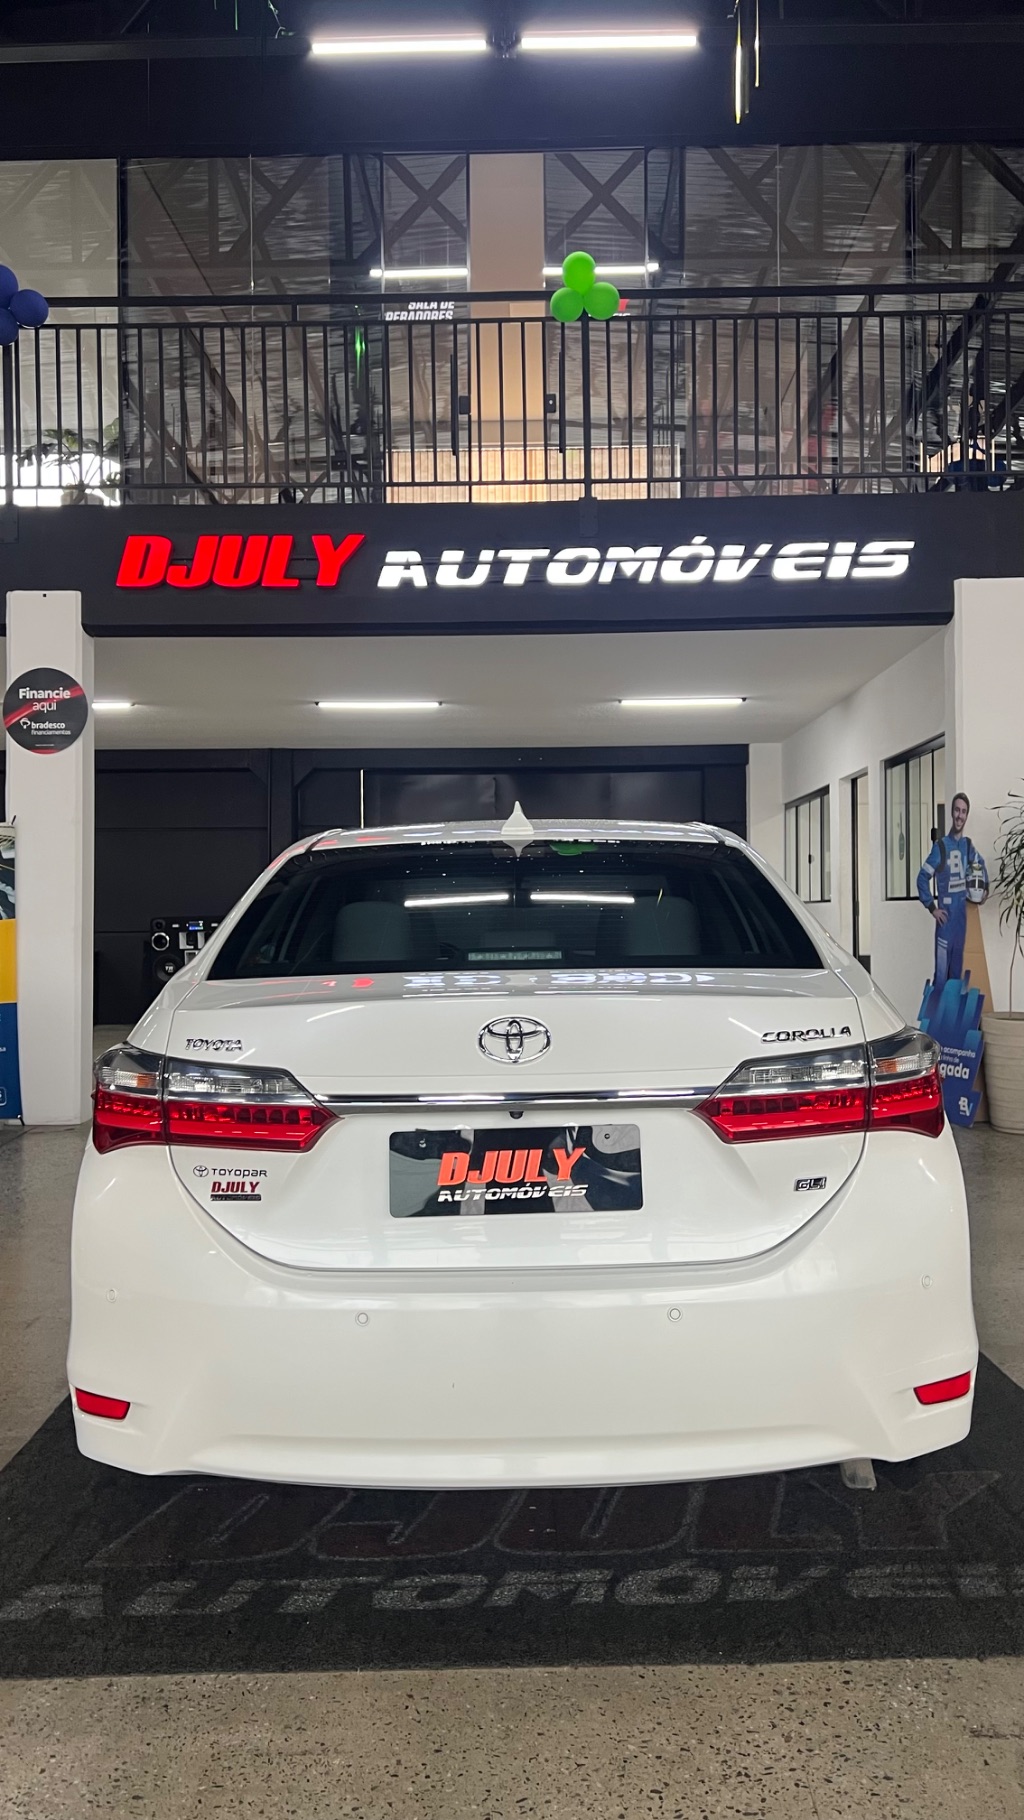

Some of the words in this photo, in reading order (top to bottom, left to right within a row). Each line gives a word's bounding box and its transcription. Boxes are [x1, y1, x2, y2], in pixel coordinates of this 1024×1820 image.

[115, 534, 365, 589] DJULY
[377, 534, 915, 588] AUTOMÓVEIS
[19, 687, 71, 699] Financie
[32, 700, 57, 713] aqui
[761, 1026, 852, 1043] COROLLA
[185, 1038, 243, 1051] TOYOTA
[940, 1063, 970, 1079] gada
[437, 1148, 586, 1186] DJULY
[211, 1181, 260, 1193] DJULY
[437, 1182, 588, 1202] AUTOMÓVEIS
